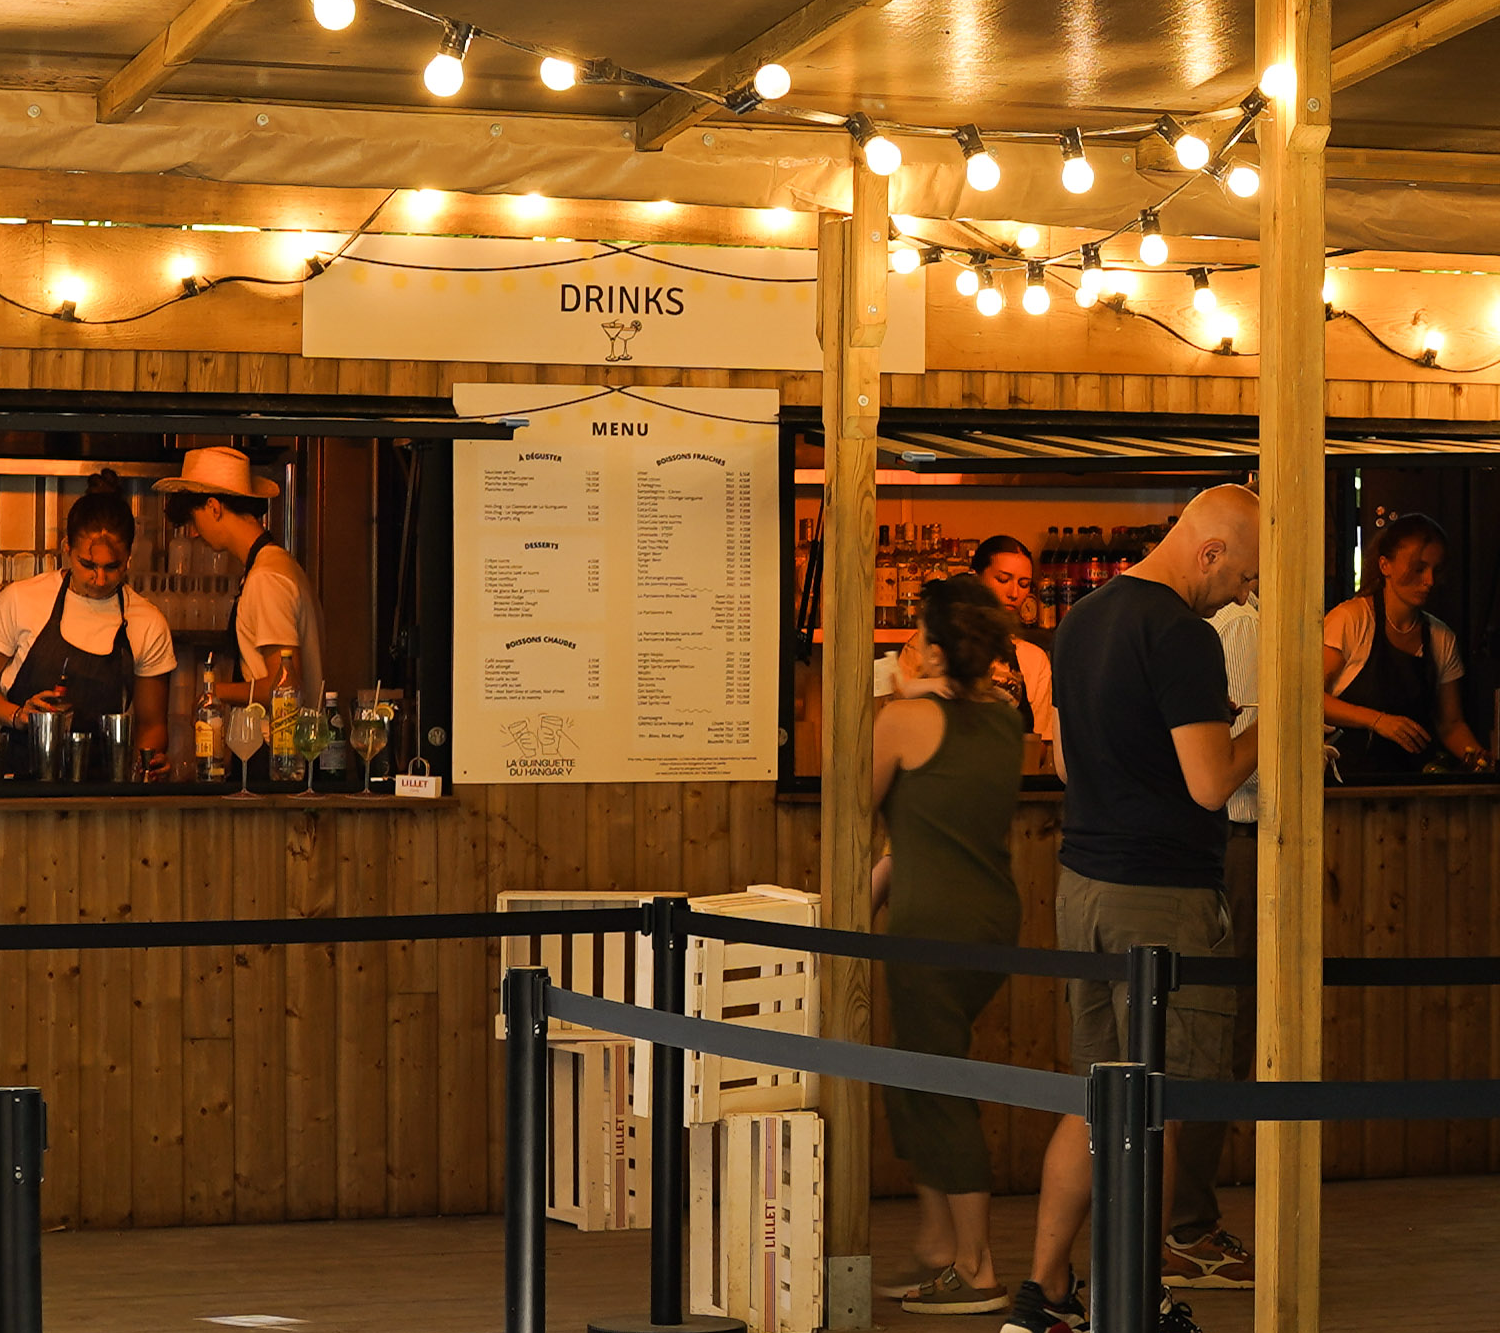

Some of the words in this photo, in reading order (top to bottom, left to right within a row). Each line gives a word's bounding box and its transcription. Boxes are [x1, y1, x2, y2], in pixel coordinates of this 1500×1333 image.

[561, 284, 684, 316] DRINKS
[592, 422, 649, 436] MENU
[656, 453, 692, 466] BOISSONS
[524, 541, 559, 550] DESSERTS
[505, 635, 541, 650] BOISSONS
[543, 635, 577, 650] CHAUDES
[506, 758, 518, 768] LA
[519, 758, 576, 768] GUINGUETTE
[509, 768, 523, 776] DU
[525, 768, 565, 776] HANGAR
[566, 768, 573, 776] Y
[401, 779, 428, 788] LILLET
[616, 1117, 624, 1156] LILLET
[764, 1202, 776, 1248] LILLET
